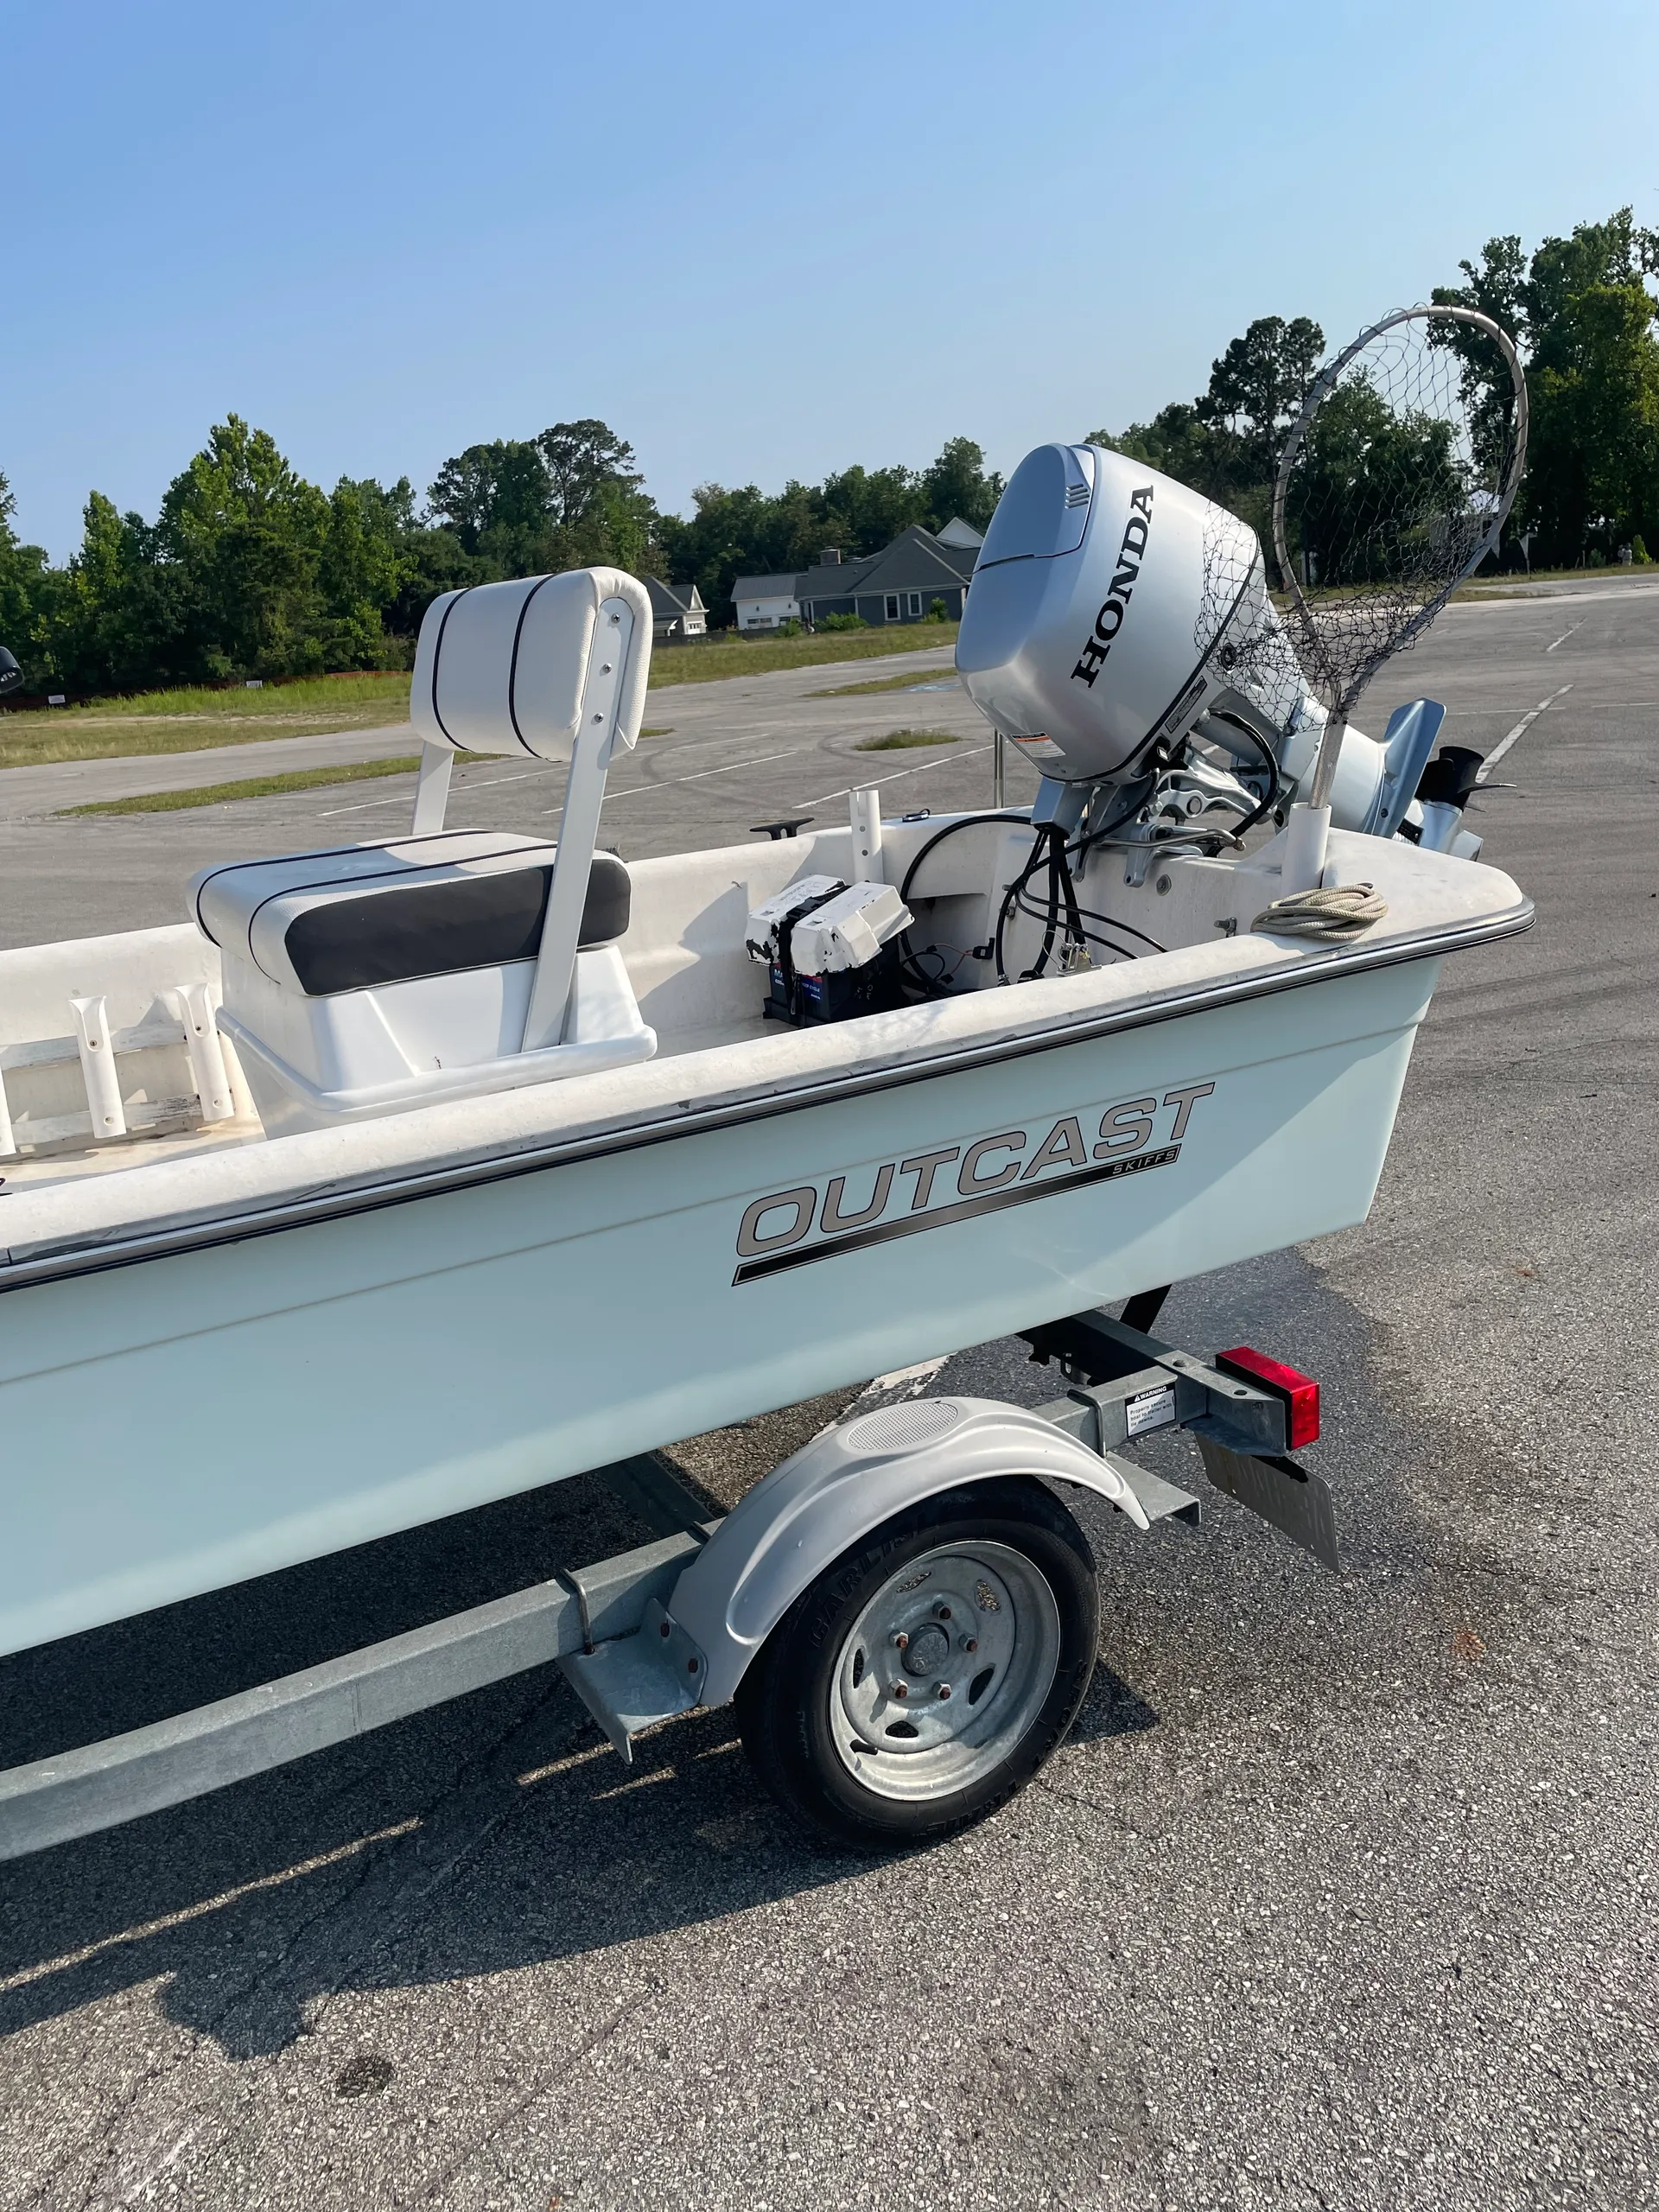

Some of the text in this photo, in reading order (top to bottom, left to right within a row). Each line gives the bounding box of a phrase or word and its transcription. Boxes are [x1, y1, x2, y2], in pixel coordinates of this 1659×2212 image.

[1070, 484, 1154, 689] HONDA
[736, 1081, 1217, 1257] OUTCAST
[1112, 1150, 1176, 1175] SKIFFS
[1140, 1386, 1166, 1399] WARNING
[1130, 1405, 1149, 1414] Properly
